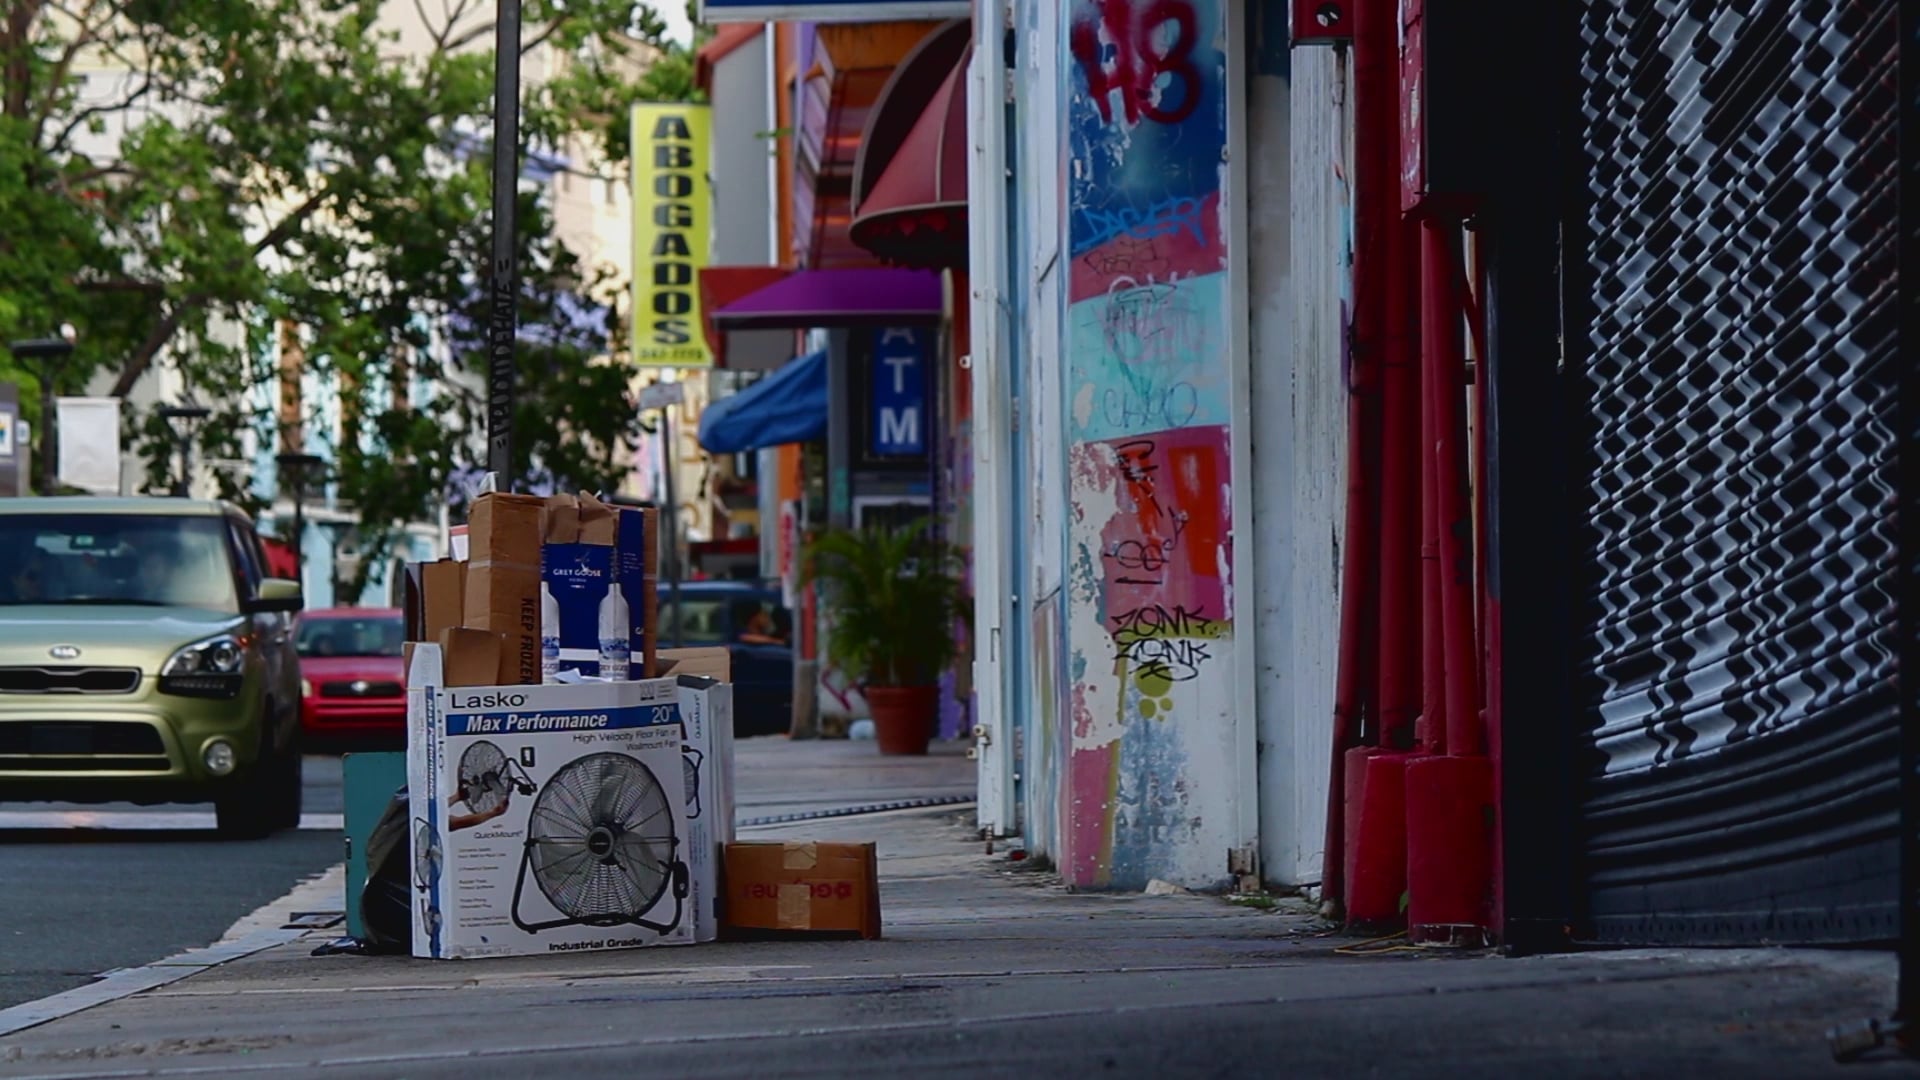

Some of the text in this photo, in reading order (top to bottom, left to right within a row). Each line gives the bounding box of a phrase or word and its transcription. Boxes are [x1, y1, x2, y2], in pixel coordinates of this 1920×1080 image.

[651, 115, 694, 345] ABOGADOS
[552, 567, 573, 577] GREY
[520, 598, 535, 631] KEEP
[451, 691, 526, 709] Lasko
[466, 715, 502, 732] Max
[505, 713, 608, 731] Performance
[572, 734, 597, 745] High
[599, 731, 634, 742] Velocity
[548, 937, 643, 951] Industrial Grade
